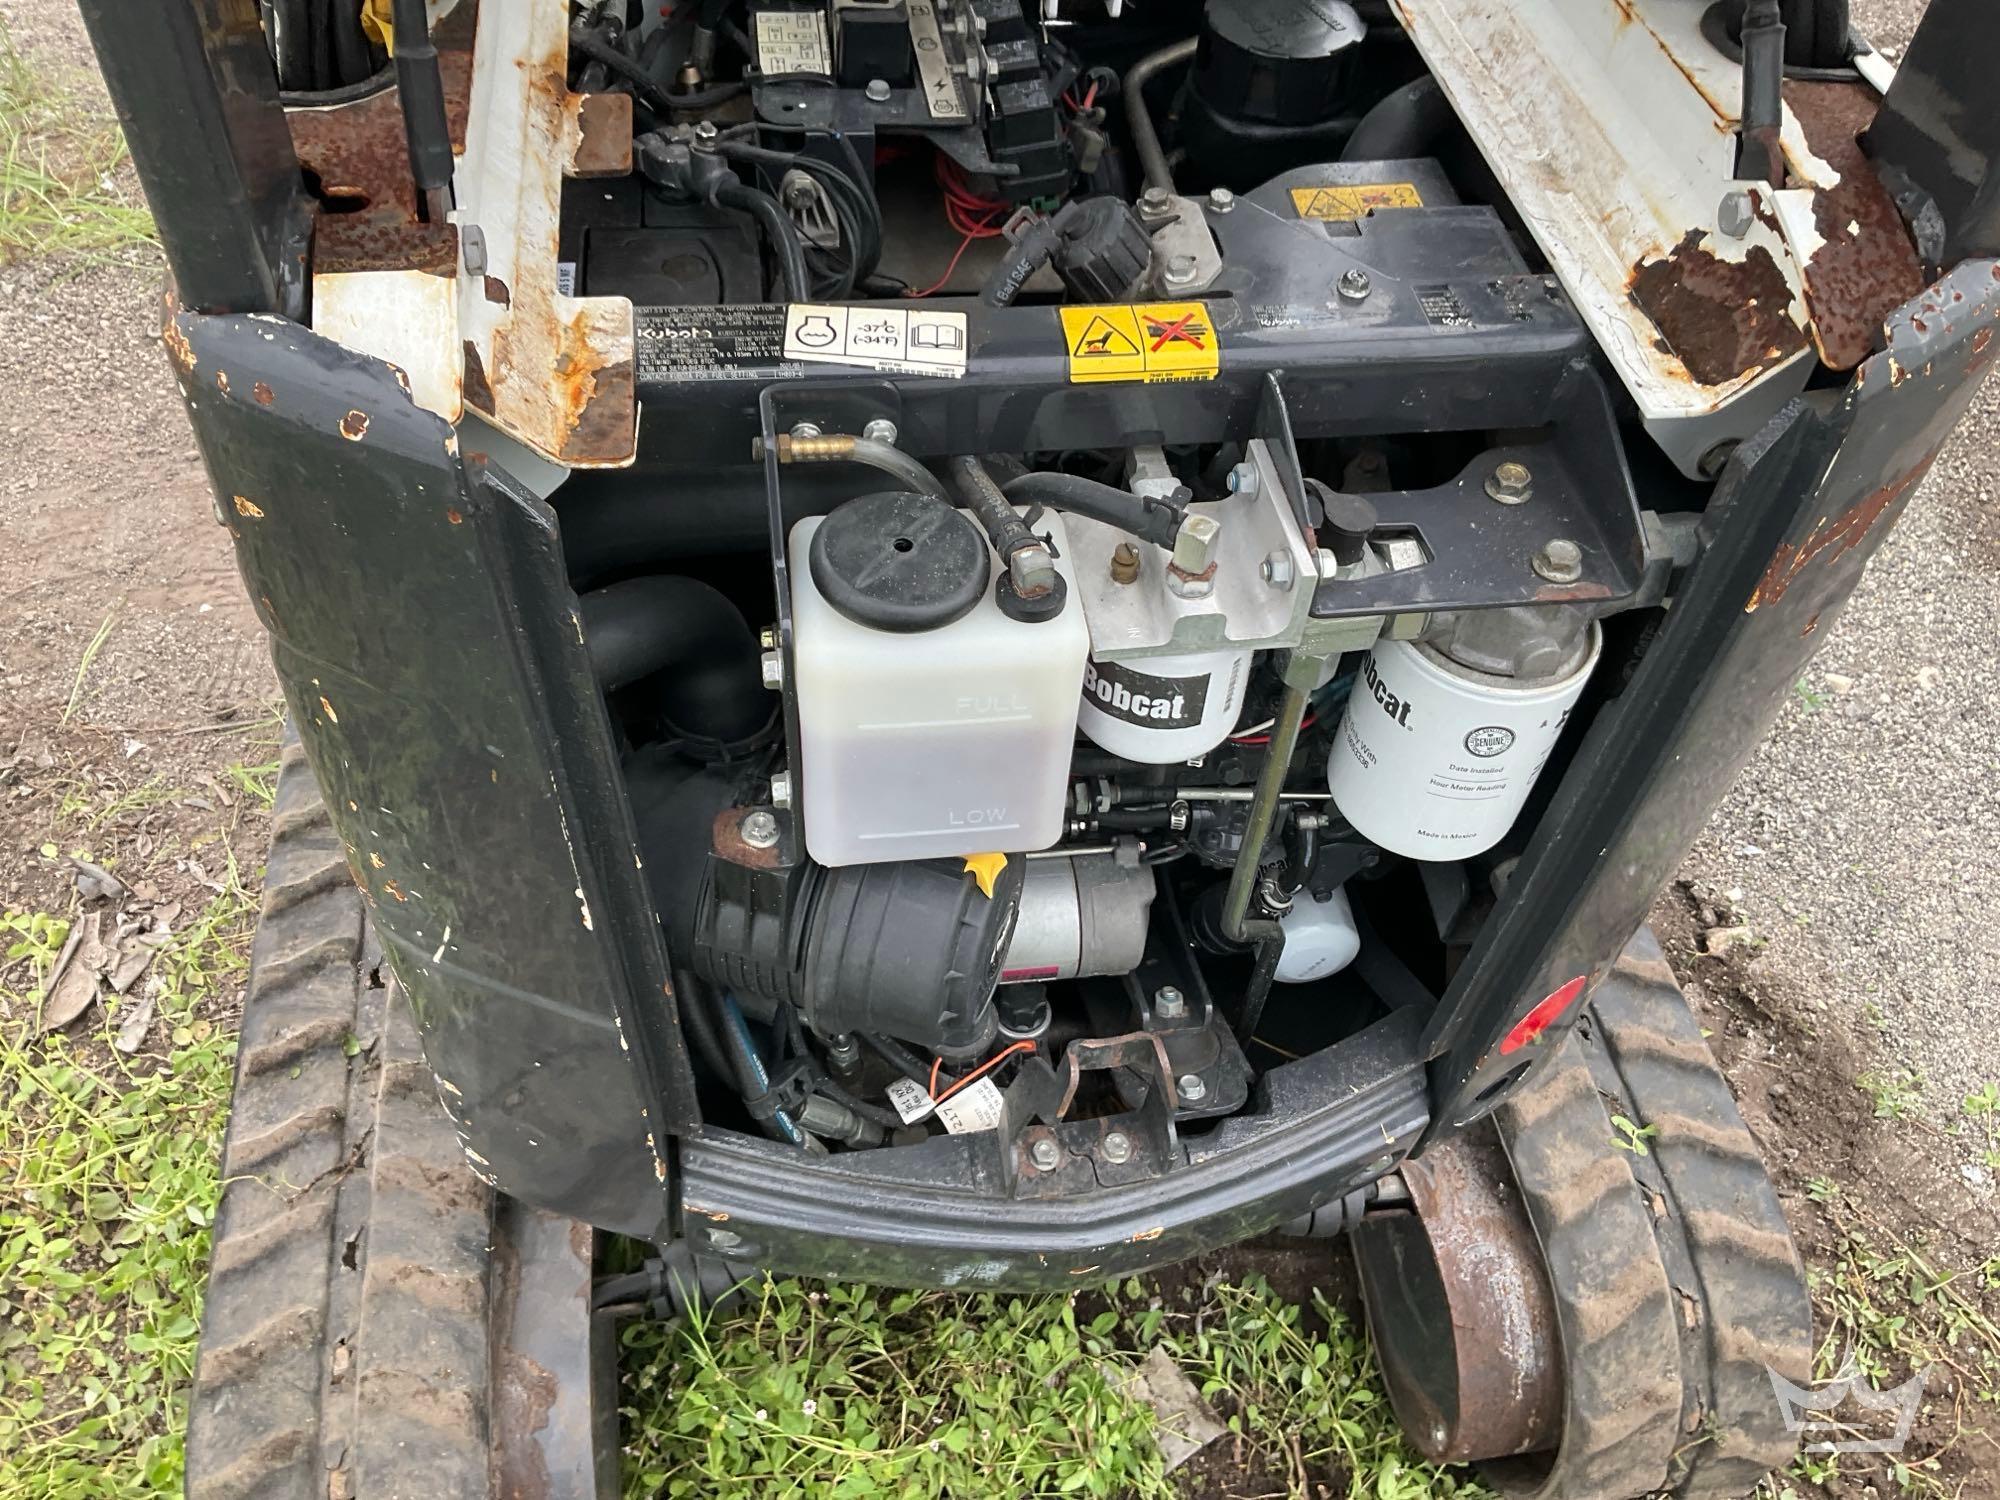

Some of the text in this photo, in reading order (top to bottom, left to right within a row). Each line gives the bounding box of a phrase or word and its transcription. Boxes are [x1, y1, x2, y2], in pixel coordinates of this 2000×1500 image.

[637, 326, 713, 340] Kubota
[1083, 659, 1185, 720] Bobcat
[956, 694, 1028, 714] FULL
[1361, 740, 1377, 765] With
[1449, 763, 1505, 774] Date Installed
[949, 807, 1006, 825] LOW
